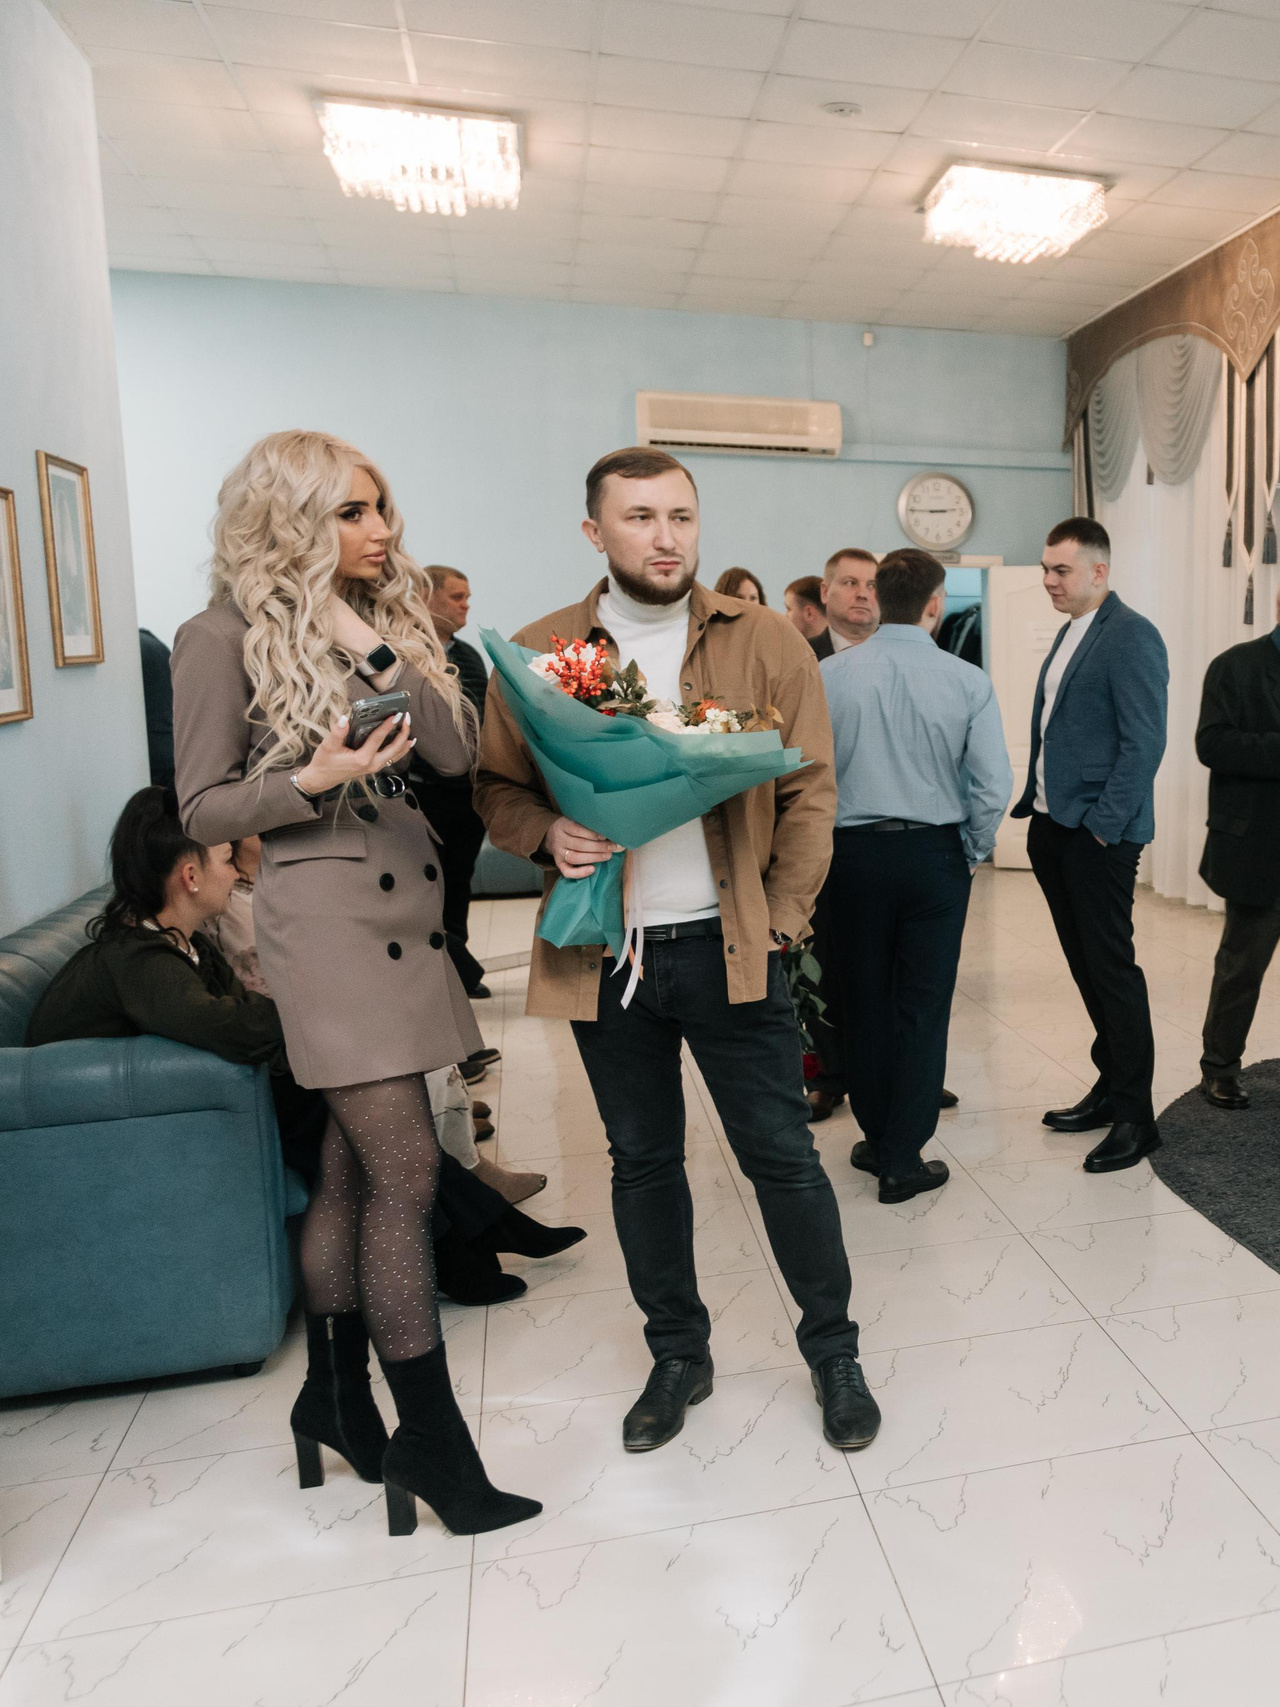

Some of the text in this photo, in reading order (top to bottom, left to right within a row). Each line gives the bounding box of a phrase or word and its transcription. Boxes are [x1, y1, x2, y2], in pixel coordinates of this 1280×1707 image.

[933, 482, 941, 491] 12
[912, 494, 921, 504] 10
[955, 495, 961, 504] 2
[959, 507, 965, 516] 3
[913, 517, 920, 527] 8
[924, 527, 930, 536] 7
[946, 528, 953, 537] 5
[935, 533, 941, 541] 6
